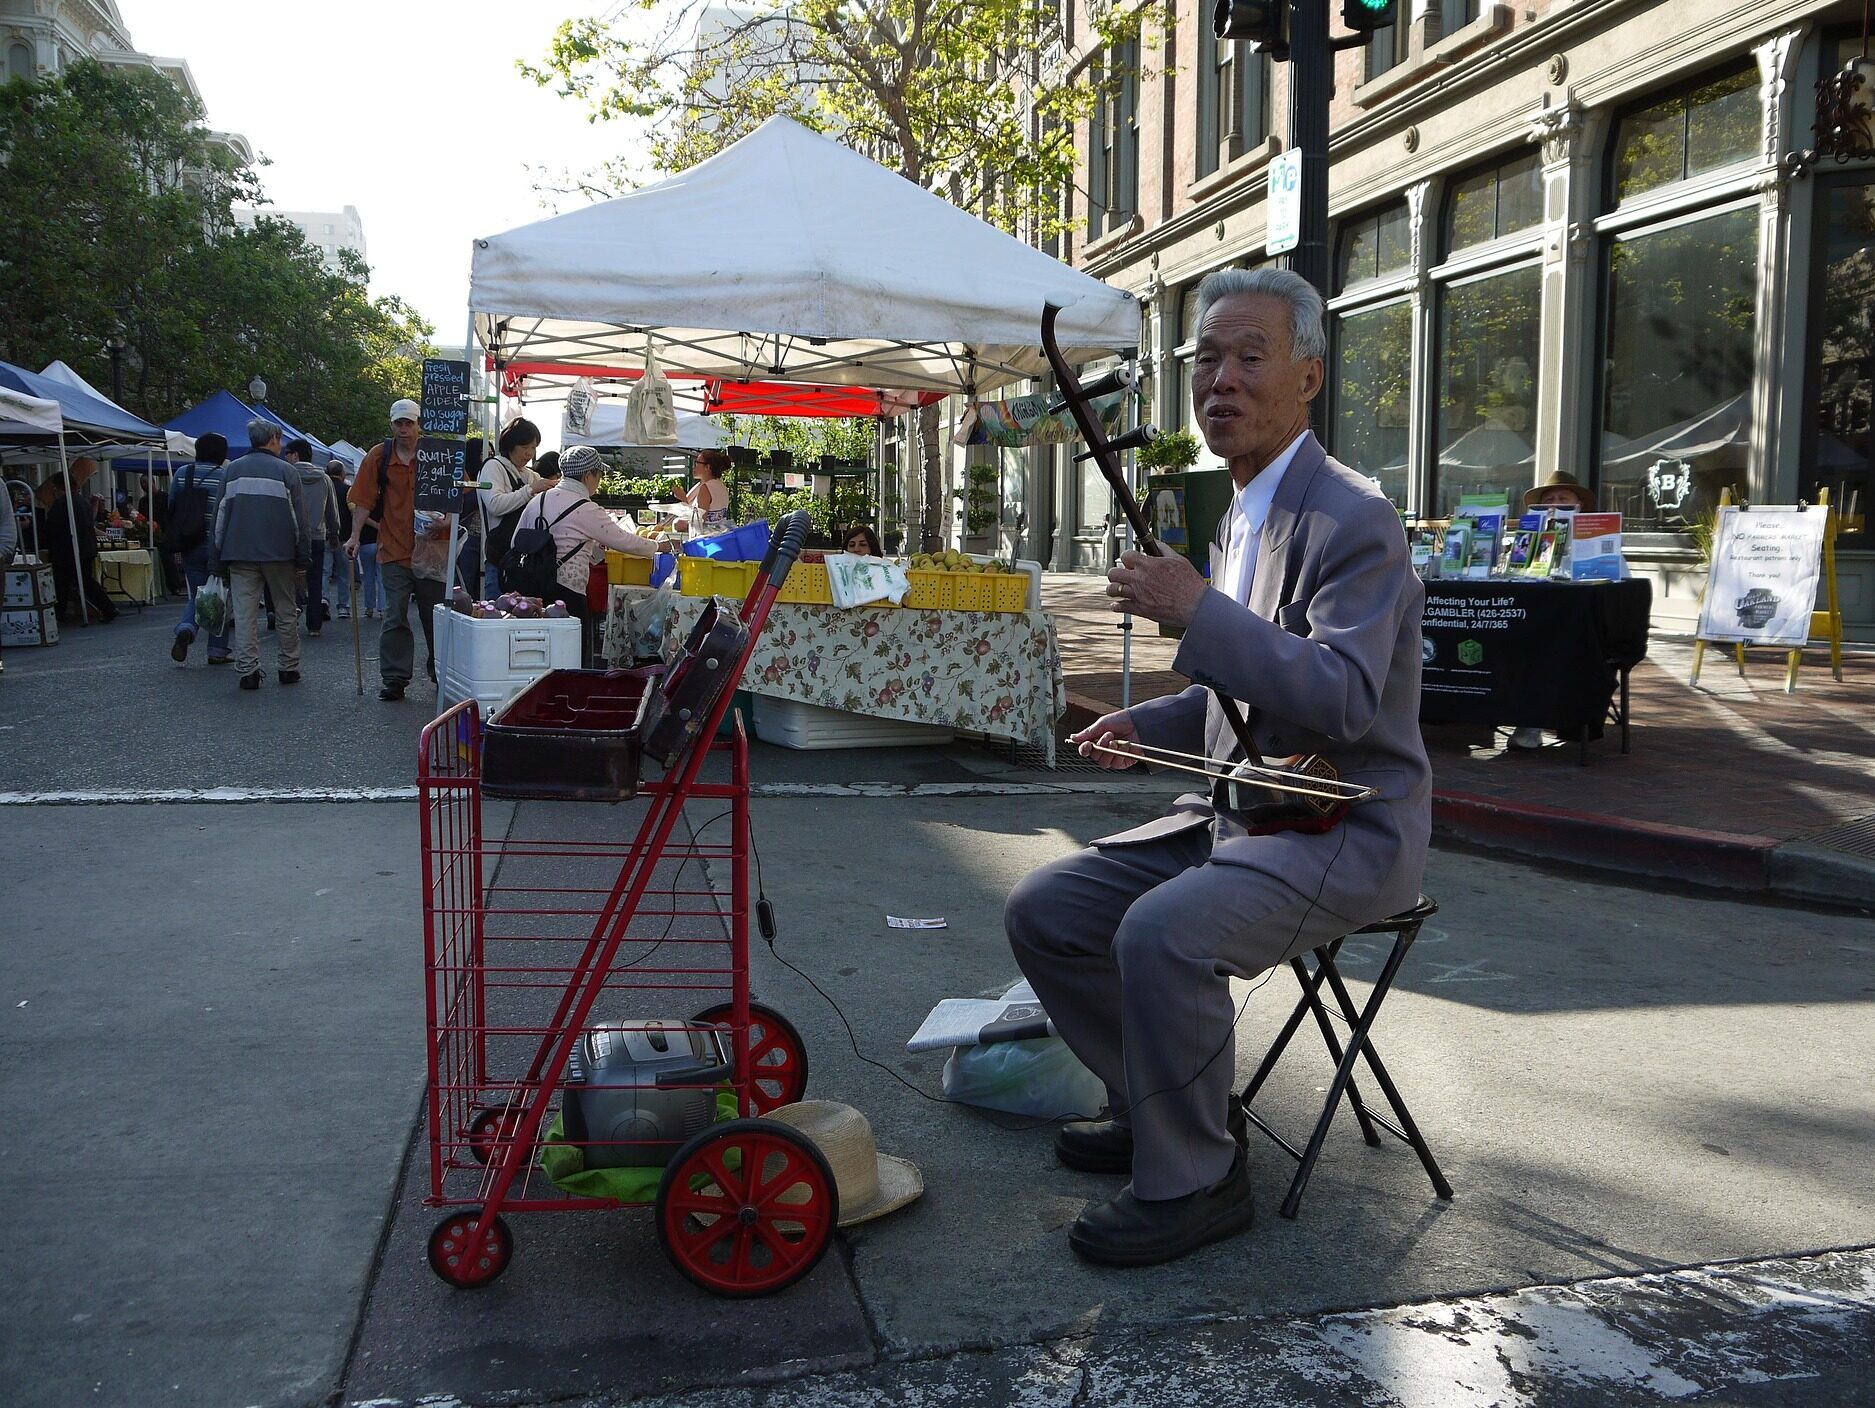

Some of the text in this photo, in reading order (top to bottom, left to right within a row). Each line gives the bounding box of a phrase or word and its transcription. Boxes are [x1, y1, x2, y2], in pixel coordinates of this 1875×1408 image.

[425, 360, 451, 374] Fresh
[427, 383, 460, 395] APPLE
[425, 396, 462, 407] CIDER
[416, 448, 464, 465] Quart 3
[452, 467, 464, 480] 5
[1660, 474, 1676, 490] B
[418, 483, 429, 496] 2
[447, 487, 459, 499] 10
[1426, 596, 1515, 607] Affecting Your Life?
[1421, 607, 1526, 620] .GAMBLER (426-2537)
[1421, 618, 1509, 629] onfidential, 24/7/365
